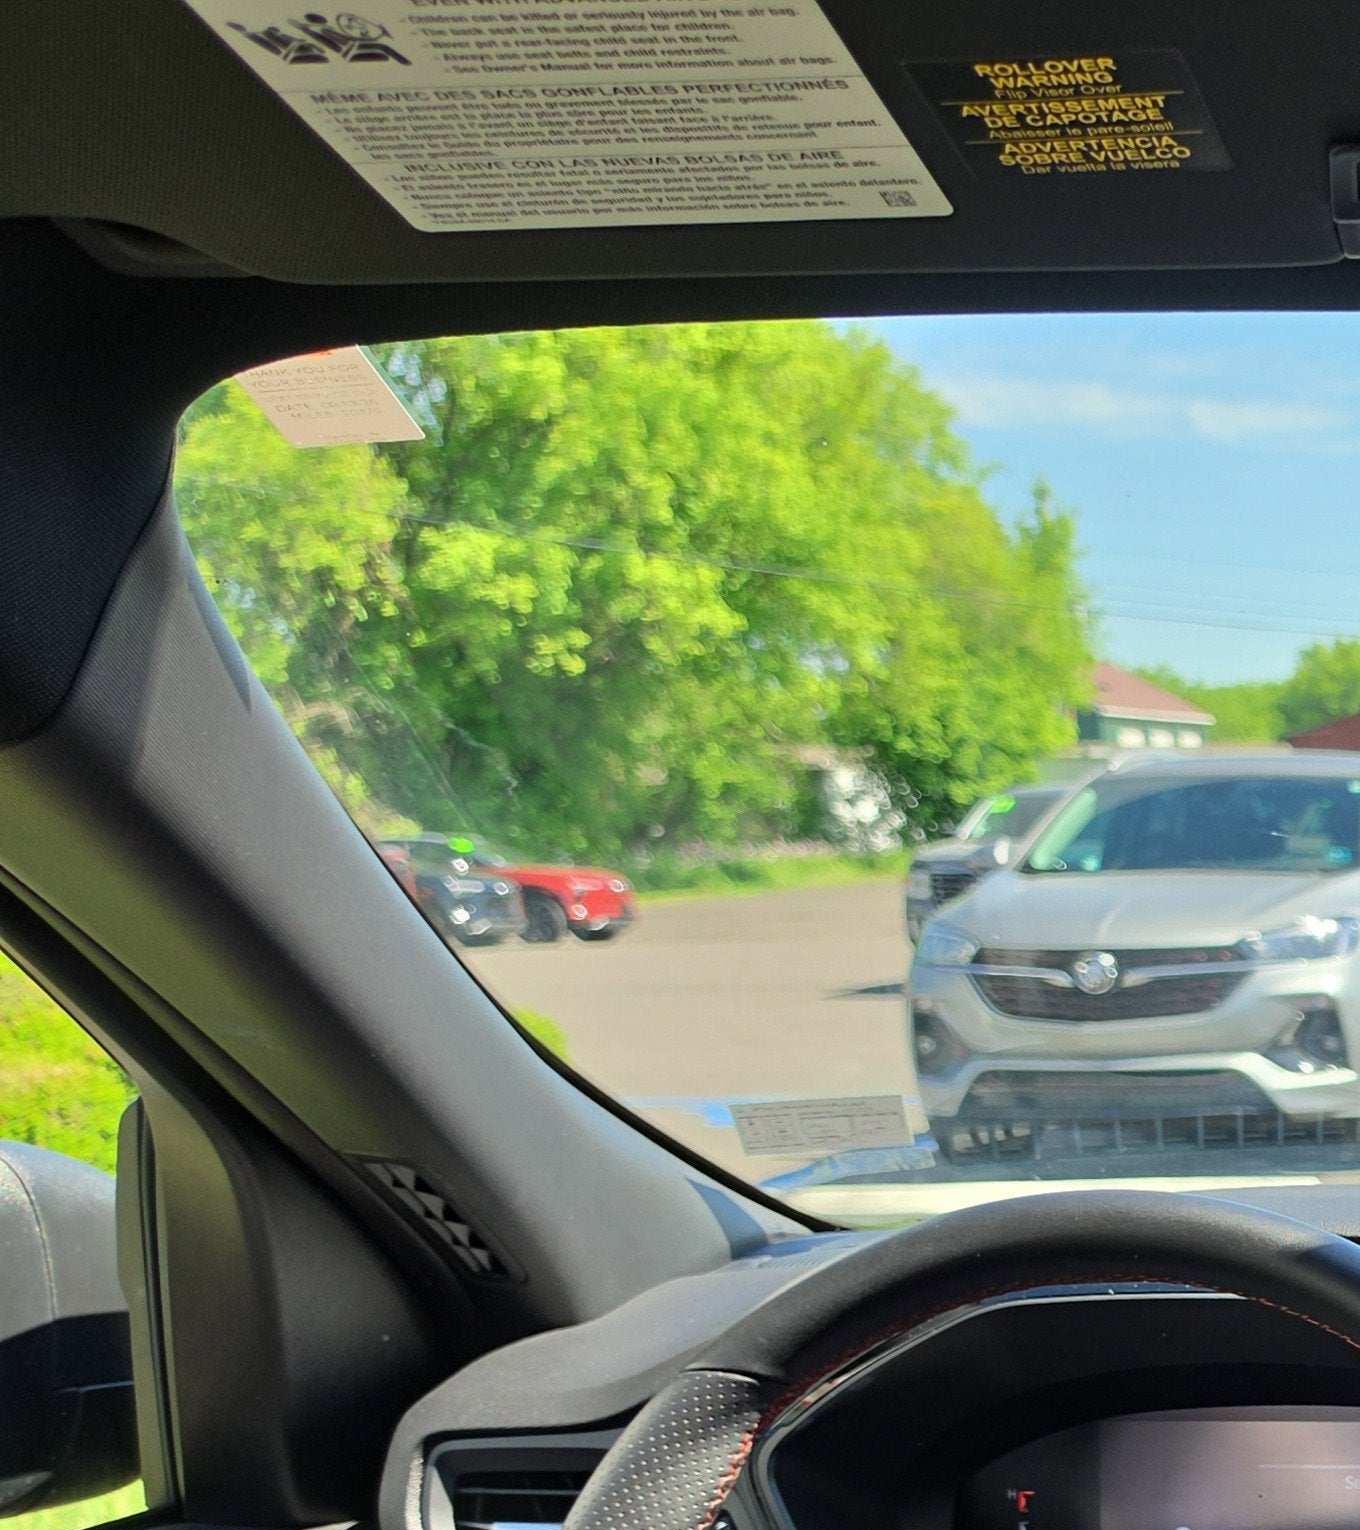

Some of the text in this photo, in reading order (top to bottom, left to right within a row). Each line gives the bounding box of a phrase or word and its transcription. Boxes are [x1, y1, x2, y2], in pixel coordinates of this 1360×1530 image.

[973, 57, 1118, 77] ROLLOVER
[989, 71, 1114, 89] WARNING
[310, 92, 371, 105] MÊME
[377, 91, 430, 102] AVEC
[433, 90, 477, 101] DES
[480, 88, 537, 100] SACS
[541, 85, 679, 99] GONFLABLES
[682, 79, 849, 95] PERFECTIONNÉS
[994, 82, 1121, 101] Flip Visor Over
[961, 95, 1166, 117] AVERTISSEMENT
[983, 107, 1164, 128] DE CAPOTAGE
[999, 146, 1191, 166] SOBRE VUELCO
[1003, 136, 1178, 156] ADVERTENCIA
[404, 161, 506, 173] INCLUSIVE
[511, 159, 554, 170] CON
[558, 158, 597, 168] LAS
[601, 154, 680, 167] NUEVAS
[684, 153, 764, 165] BOLSAS
[767, 152, 793, 162] DE
[800, 150, 844, 161] AIRE
